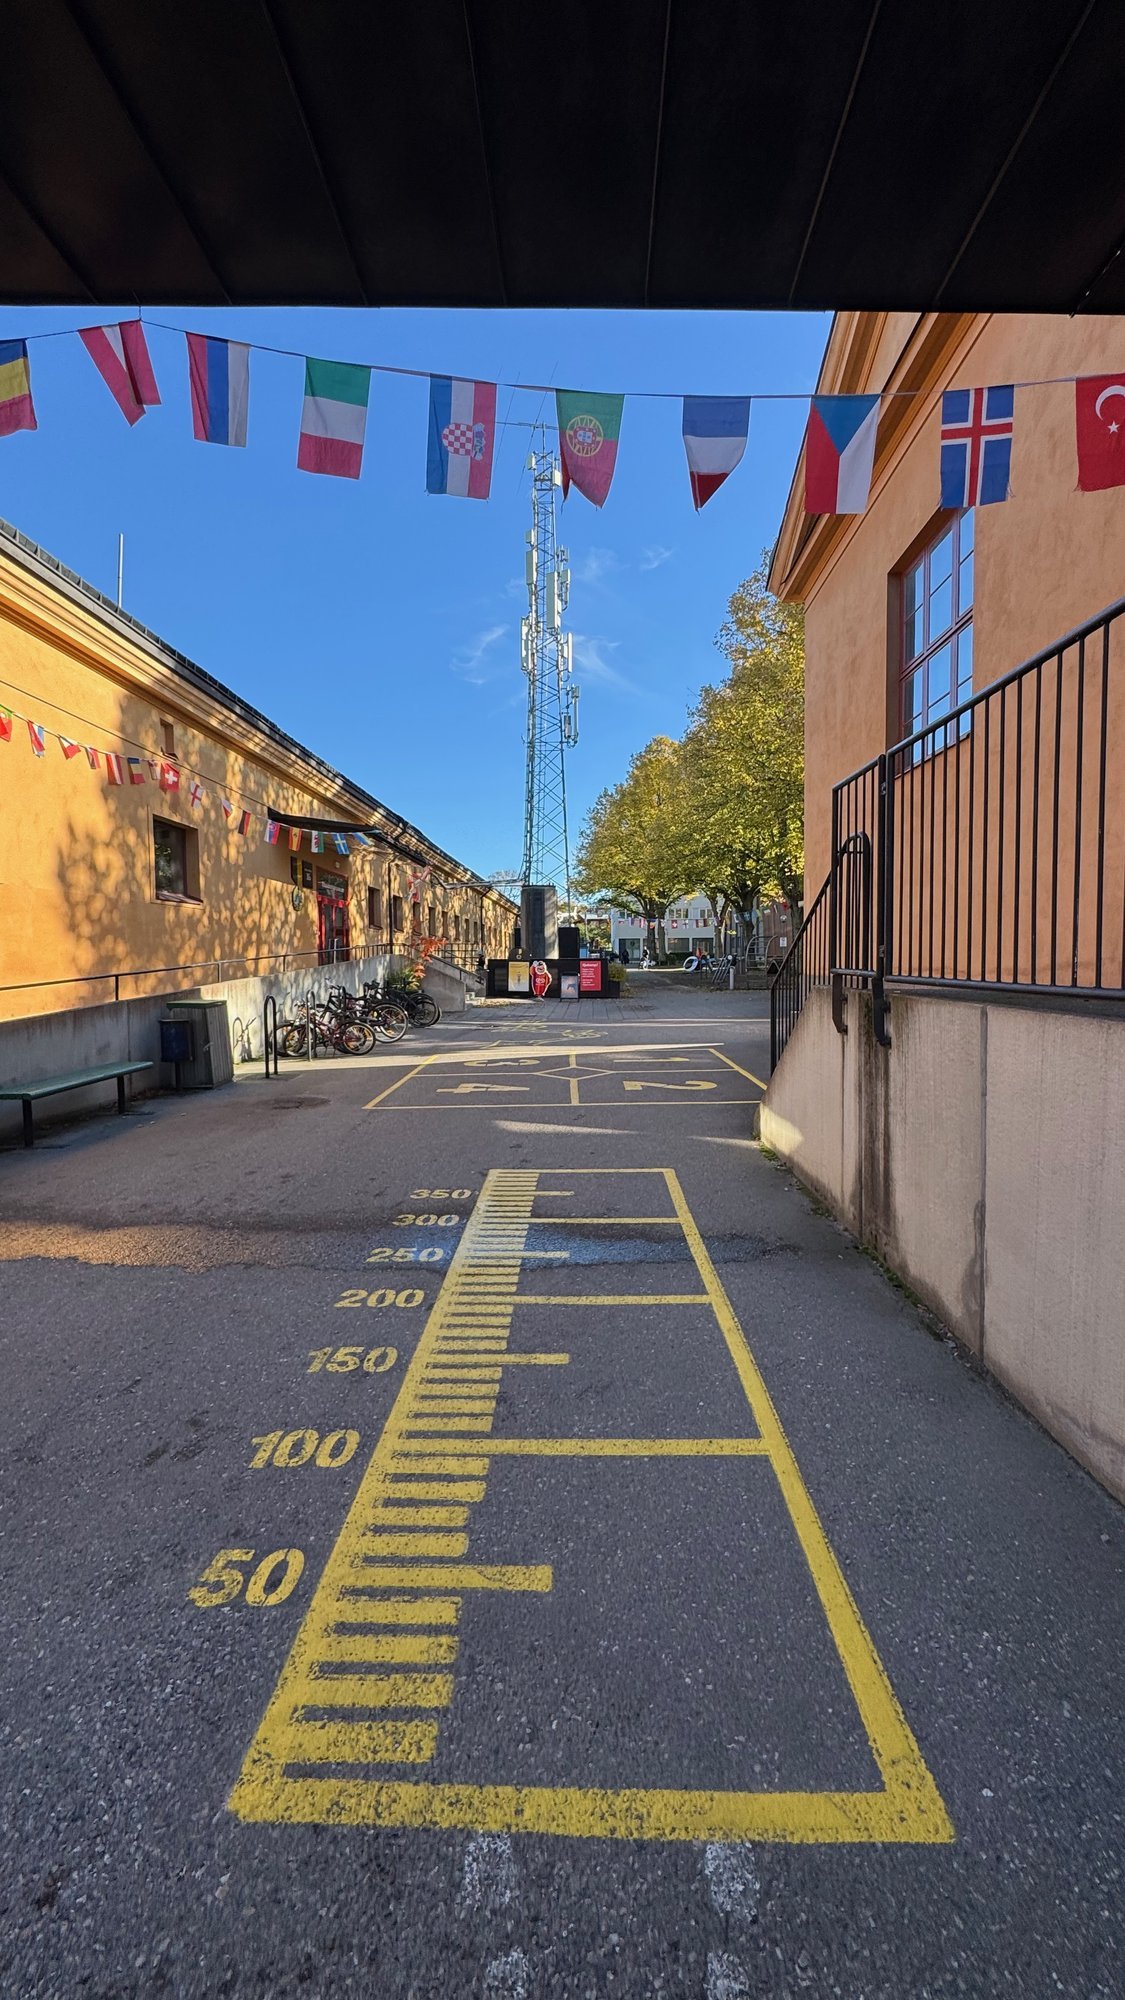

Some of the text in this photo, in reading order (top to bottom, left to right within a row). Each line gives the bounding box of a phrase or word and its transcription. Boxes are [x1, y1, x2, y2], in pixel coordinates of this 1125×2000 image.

[436, 1083, 530, 1094] 4
[622, 1080, 718, 1092] 2
[409, 1188, 472, 1200] 350
[391, 1213, 461, 1227] 300
[364, 1246, 445, 1263] 250
[333, 1288, 425, 1309] 200
[307, 1345, 399, 1374] 150
[248, 1428, 361, 1469] 100
[186, 1547, 306, 1608] 50
